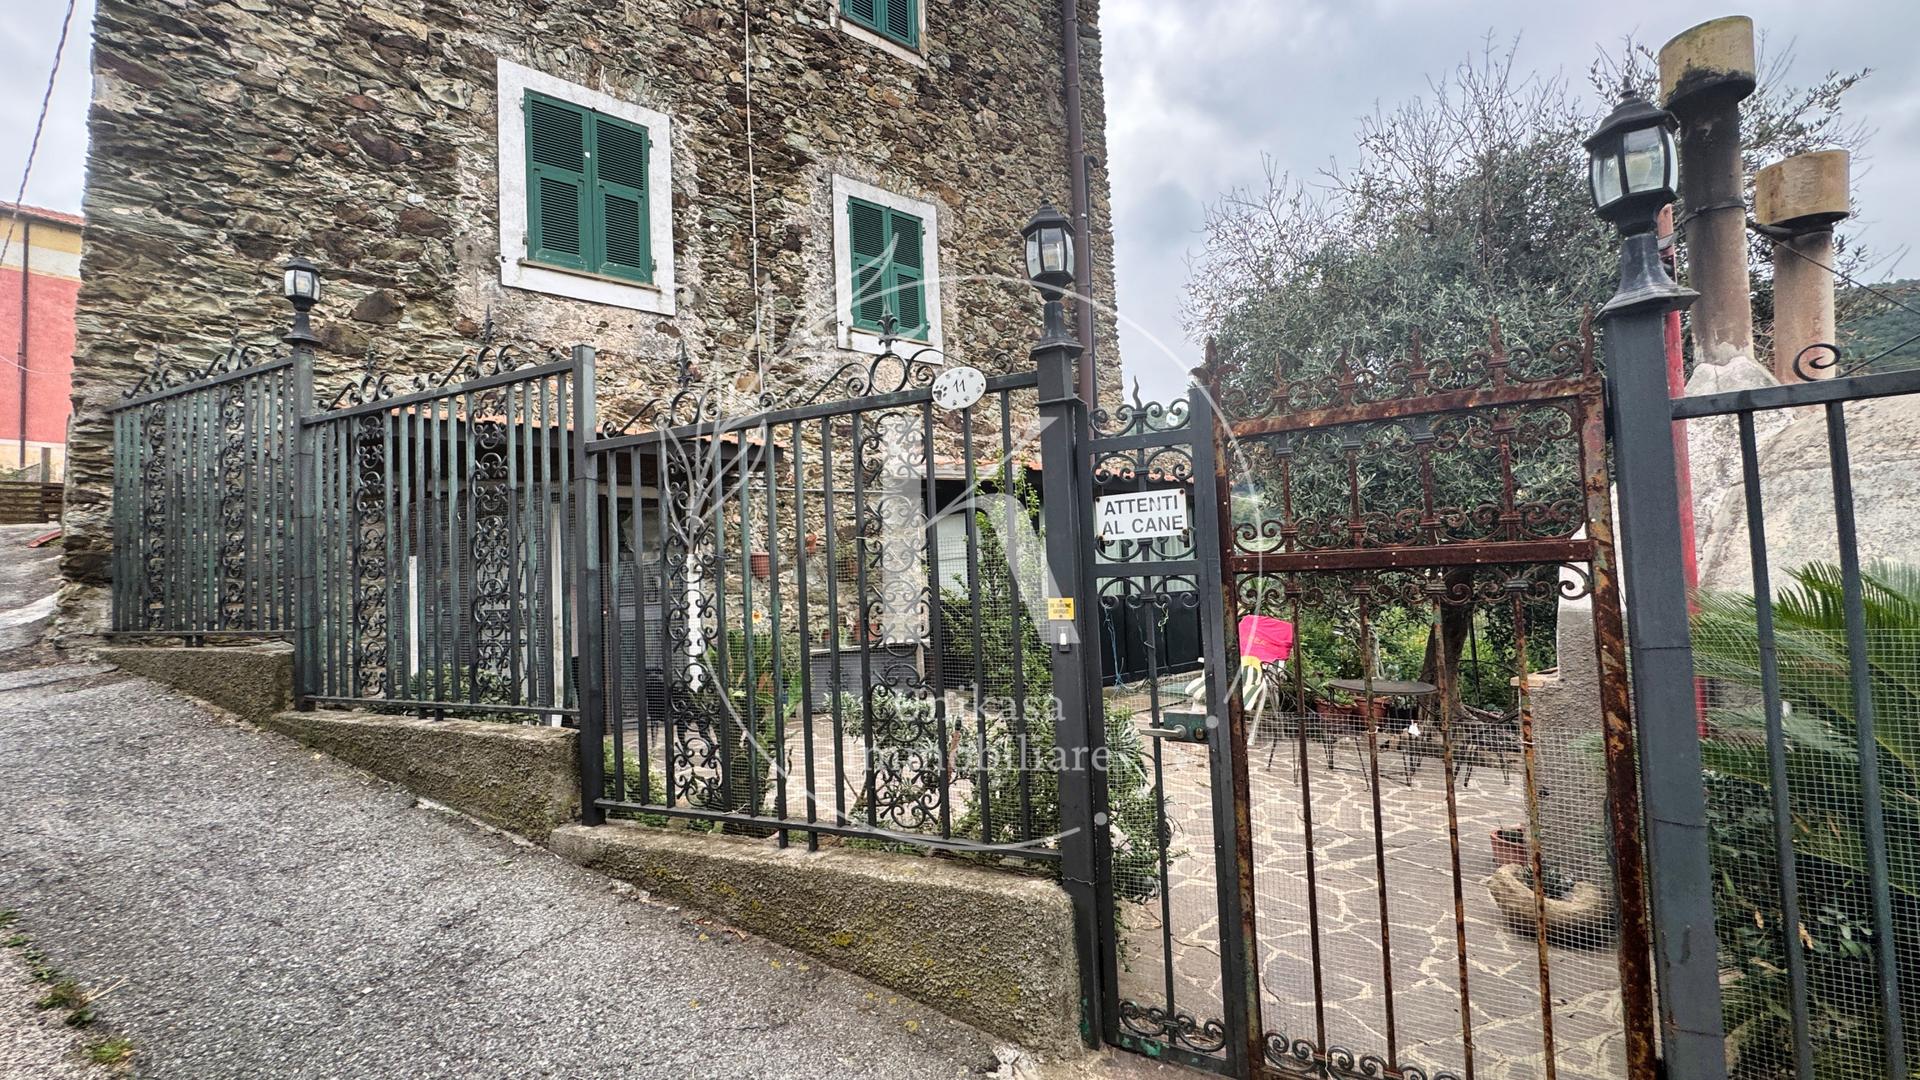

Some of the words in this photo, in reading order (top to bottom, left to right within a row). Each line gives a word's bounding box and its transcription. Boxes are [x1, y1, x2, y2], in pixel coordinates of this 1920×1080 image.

[952, 379, 966, 393] 11
[1104, 495, 1178, 516] ATTENTI
[1102, 520, 1125, 536] AL
[1132, 515, 1184, 534] CANE
